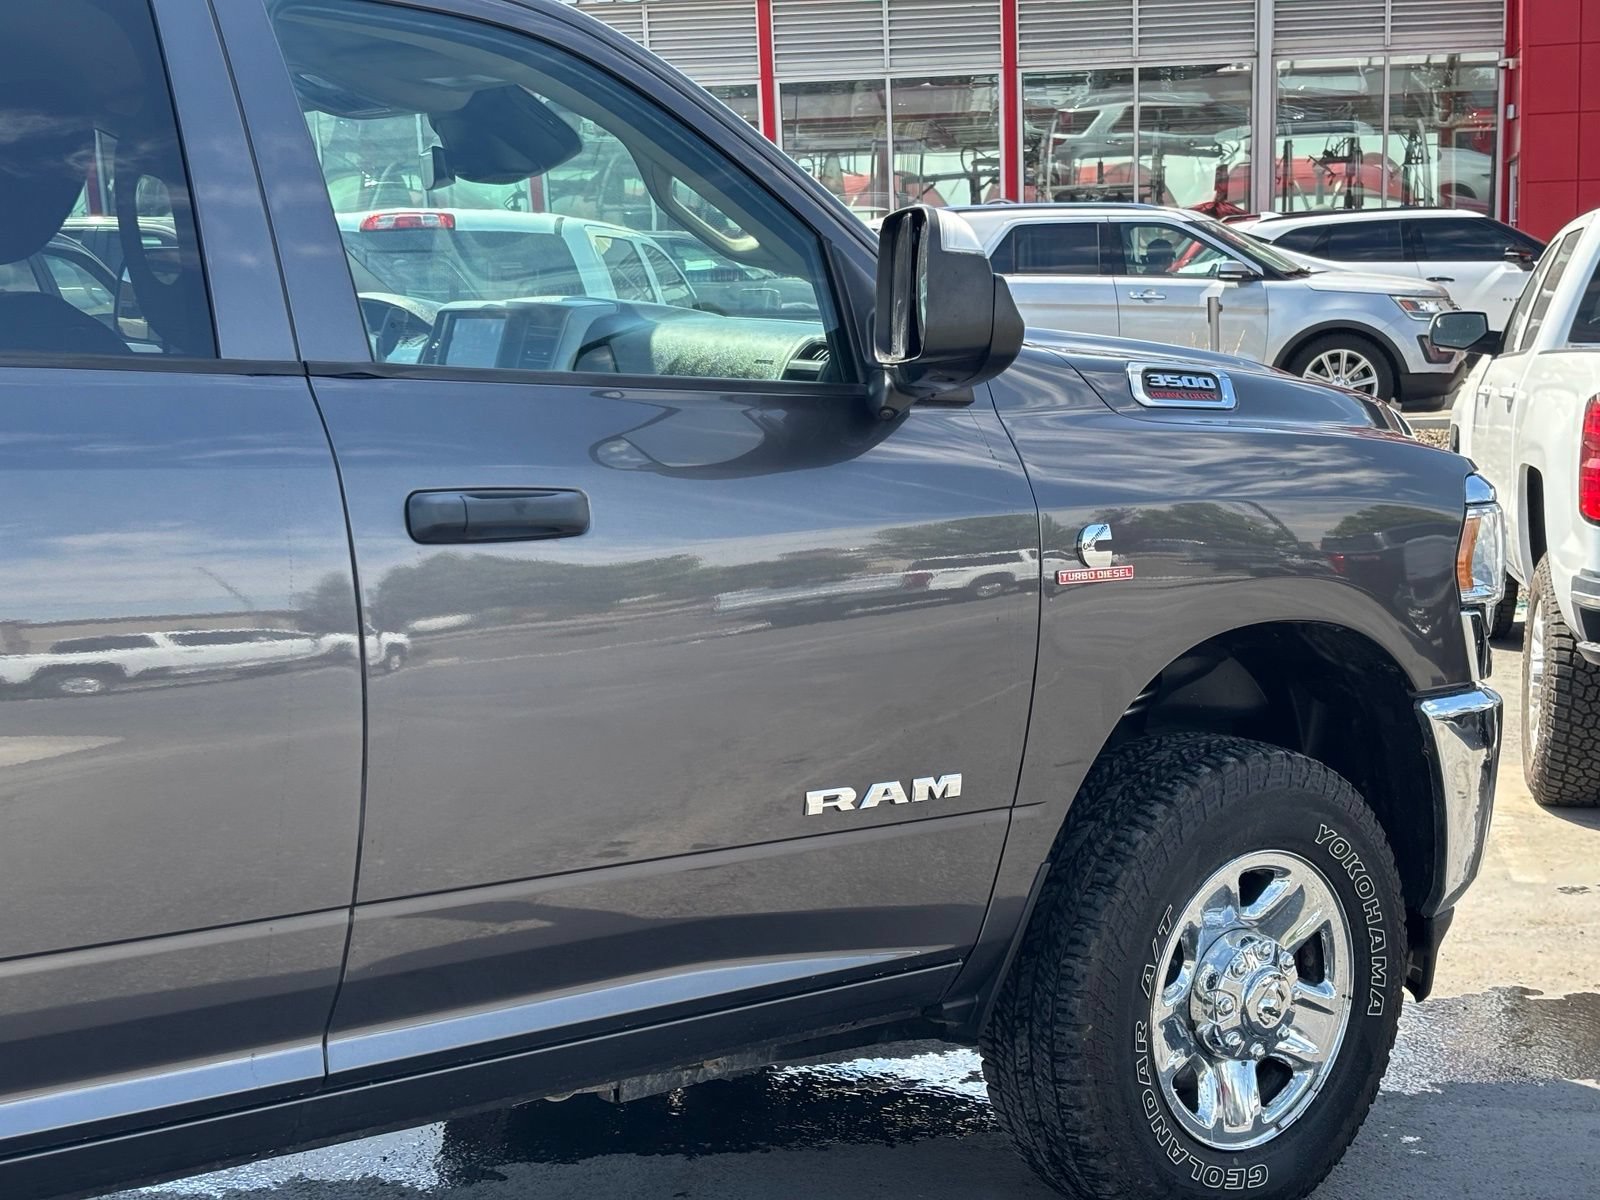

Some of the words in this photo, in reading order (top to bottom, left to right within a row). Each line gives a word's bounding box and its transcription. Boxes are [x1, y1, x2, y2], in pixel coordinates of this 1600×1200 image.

[1146, 374, 1216, 389] 3500
[1083, 524, 1108, 550] Cummins
[1061, 571, 1095, 581] TURBO
[1097, 568, 1132, 579] DIESEL
[803, 773, 963, 816] RAM
[1315, 824, 1387, 1016] YOKOHAMA
[1141, 905, 1173, 999] A/T
[1135, 1020, 1269, 1190] GEOLANDAR
